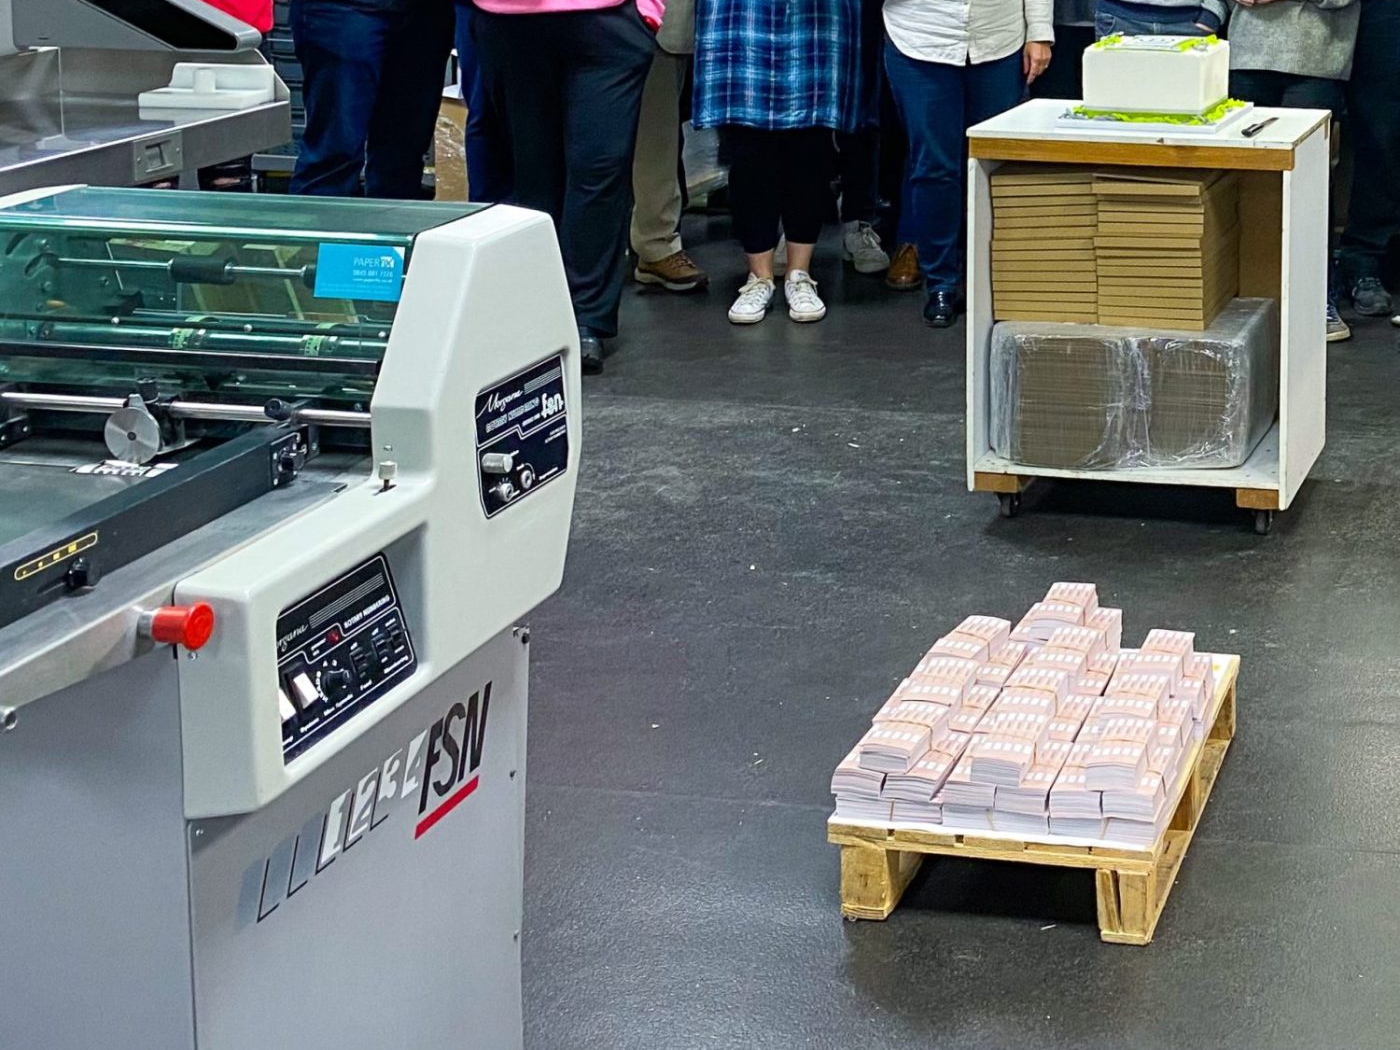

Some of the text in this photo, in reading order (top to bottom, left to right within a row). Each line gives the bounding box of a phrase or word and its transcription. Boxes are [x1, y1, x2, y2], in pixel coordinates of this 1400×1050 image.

[476, 390, 524, 420] Morgana
[276, 623, 308, 653] organa
[418, 680, 493, 816] FSN
